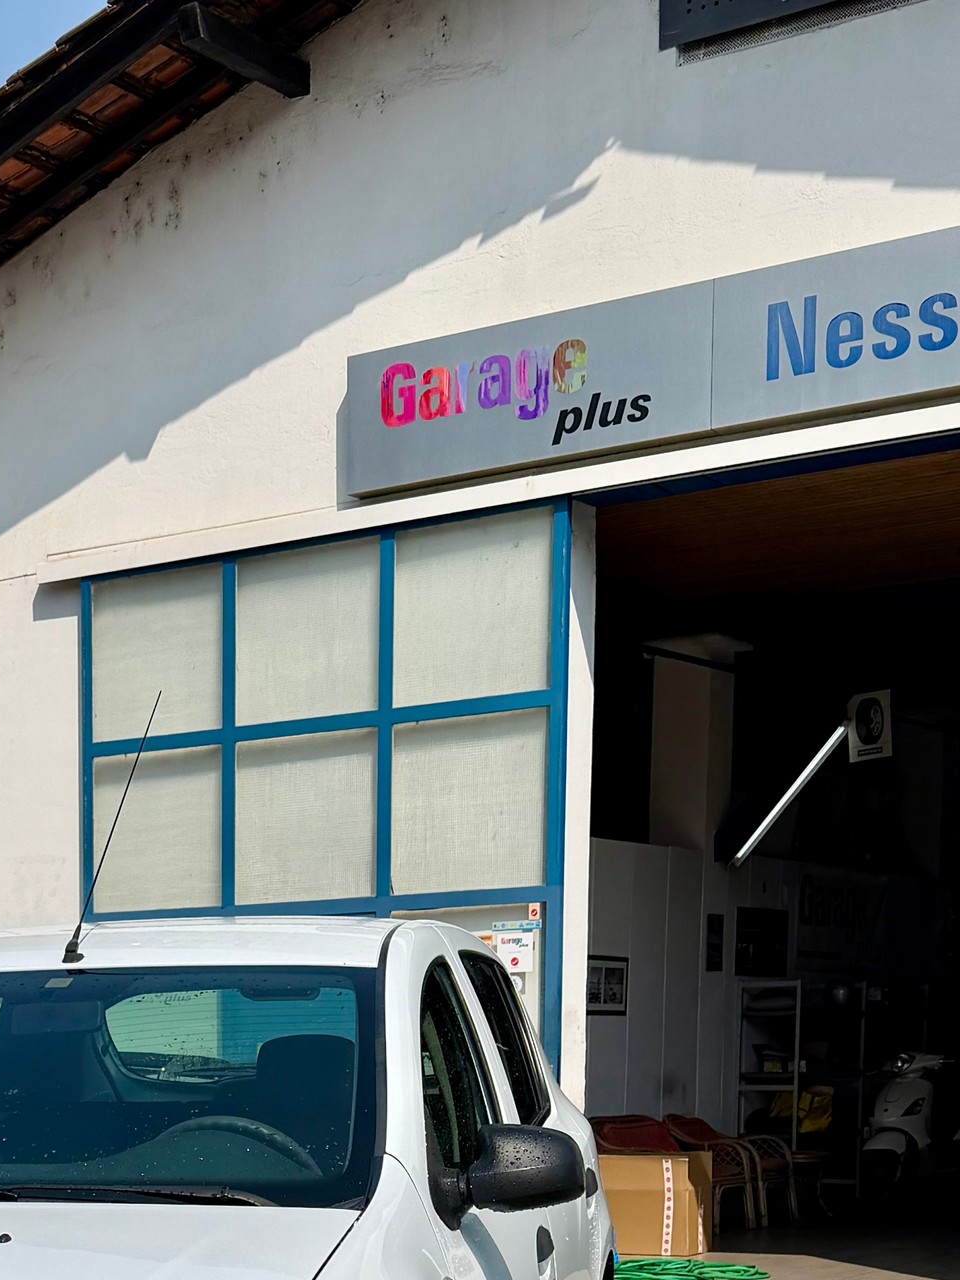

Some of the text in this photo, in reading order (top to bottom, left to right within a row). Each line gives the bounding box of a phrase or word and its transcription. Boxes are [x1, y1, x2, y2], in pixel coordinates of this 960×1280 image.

[766, 291, 959, 381] Ness
[380, 338, 589, 428] Garage
[551, 392, 651, 446] plus
[501, 937, 523, 945] Garage
